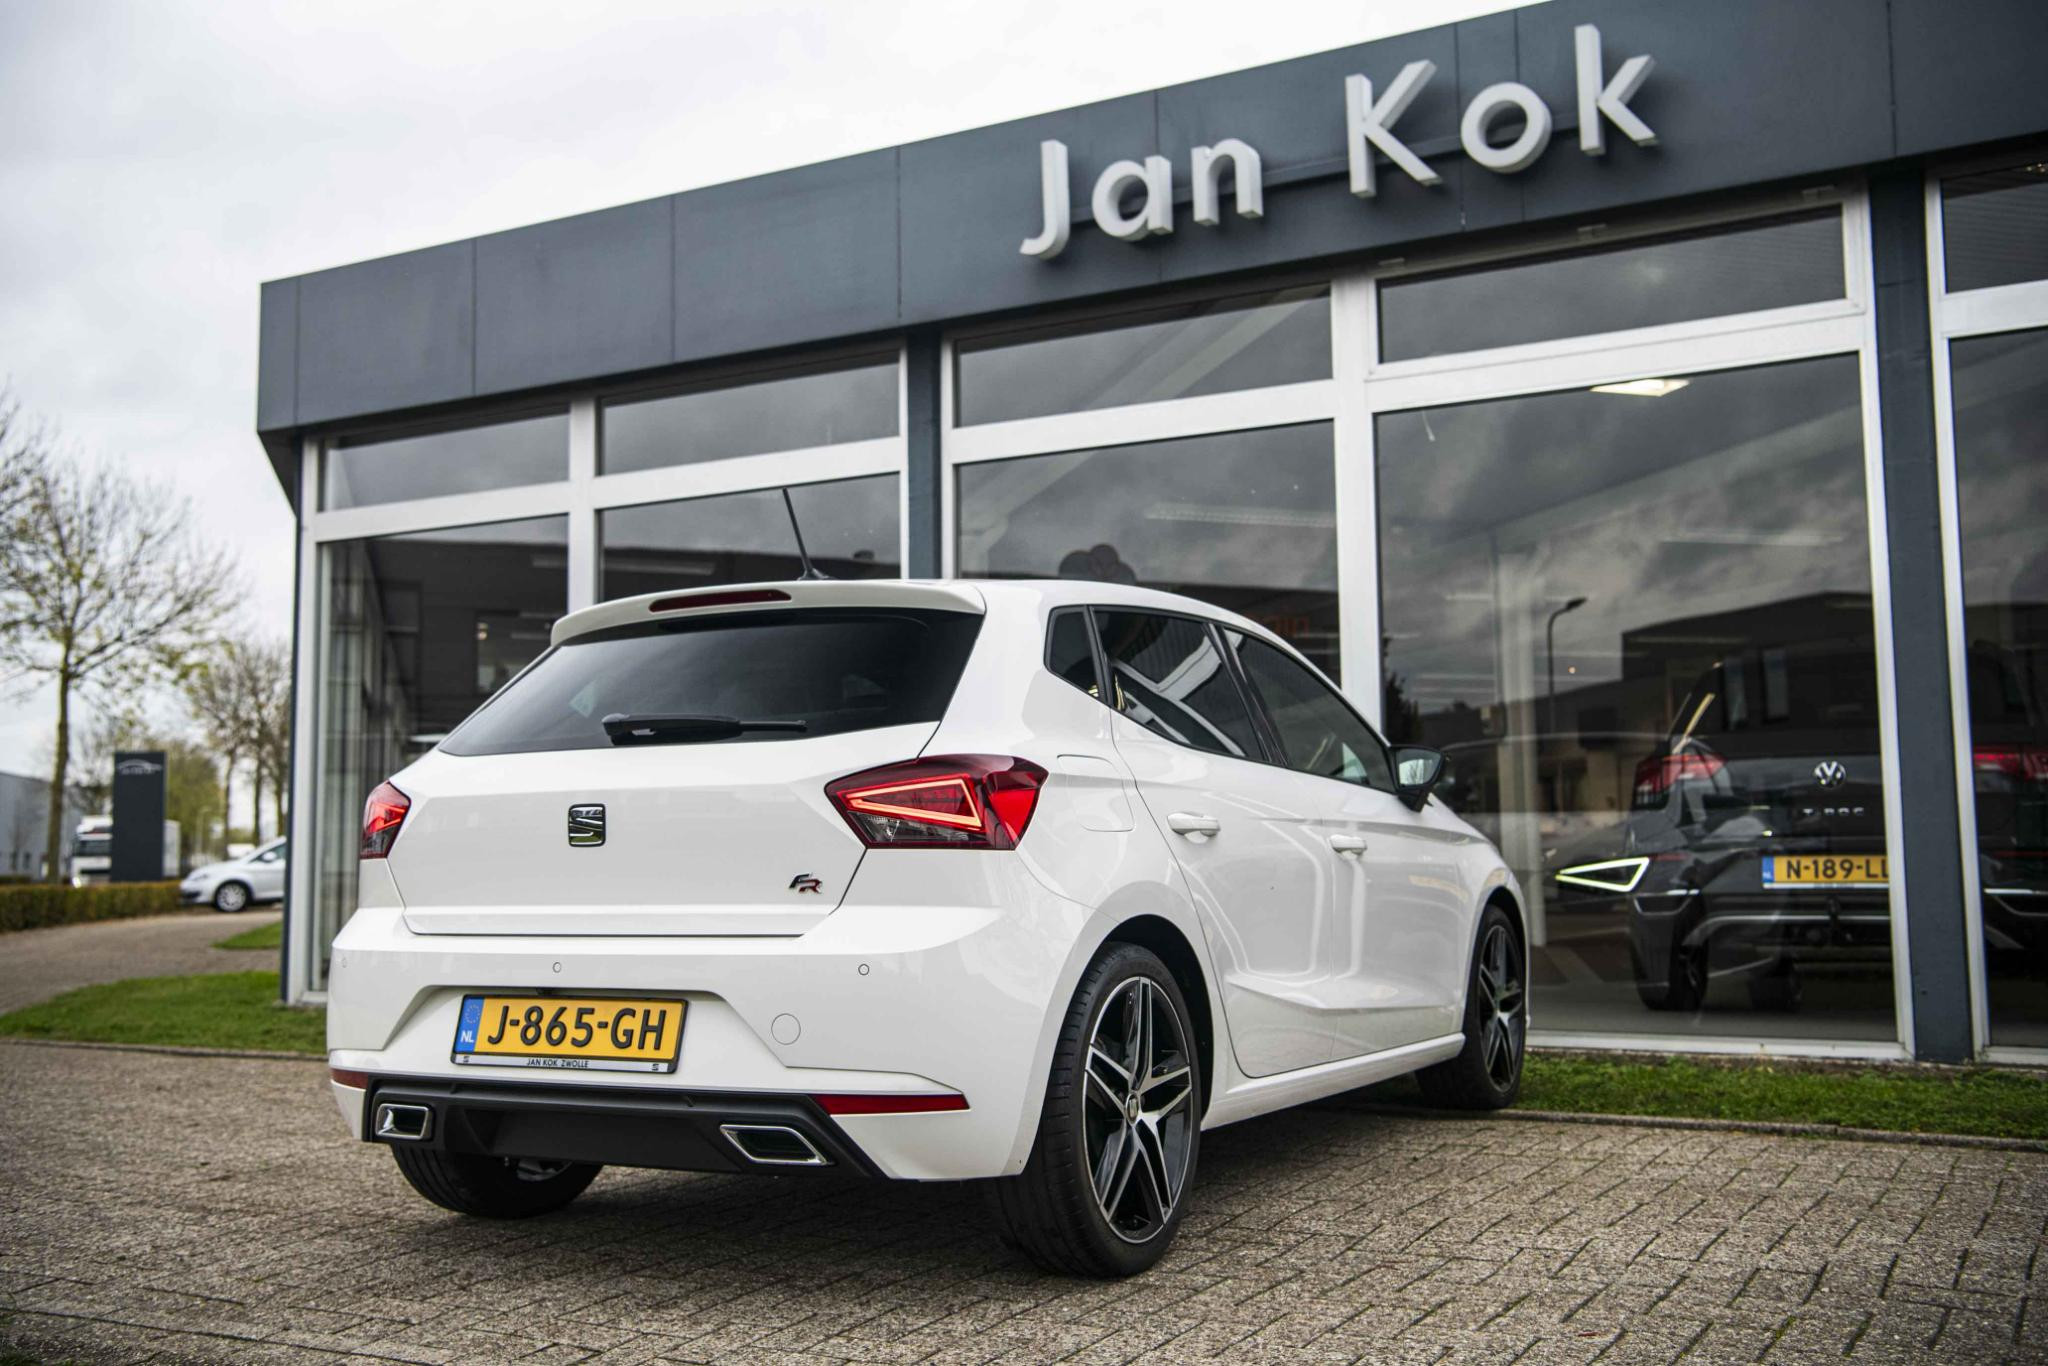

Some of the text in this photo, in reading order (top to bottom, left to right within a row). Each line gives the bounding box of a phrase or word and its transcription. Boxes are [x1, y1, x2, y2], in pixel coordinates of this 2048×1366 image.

[1020, 23, 1659, 260] Jan Kok
[789, 873, 822, 894] FR
[461, 1030, 475, 1043] NL
[487, 1005, 667, 1051] J-865-GH
[526, 1057, 589, 1068] JAN KOK ZWOLLE
